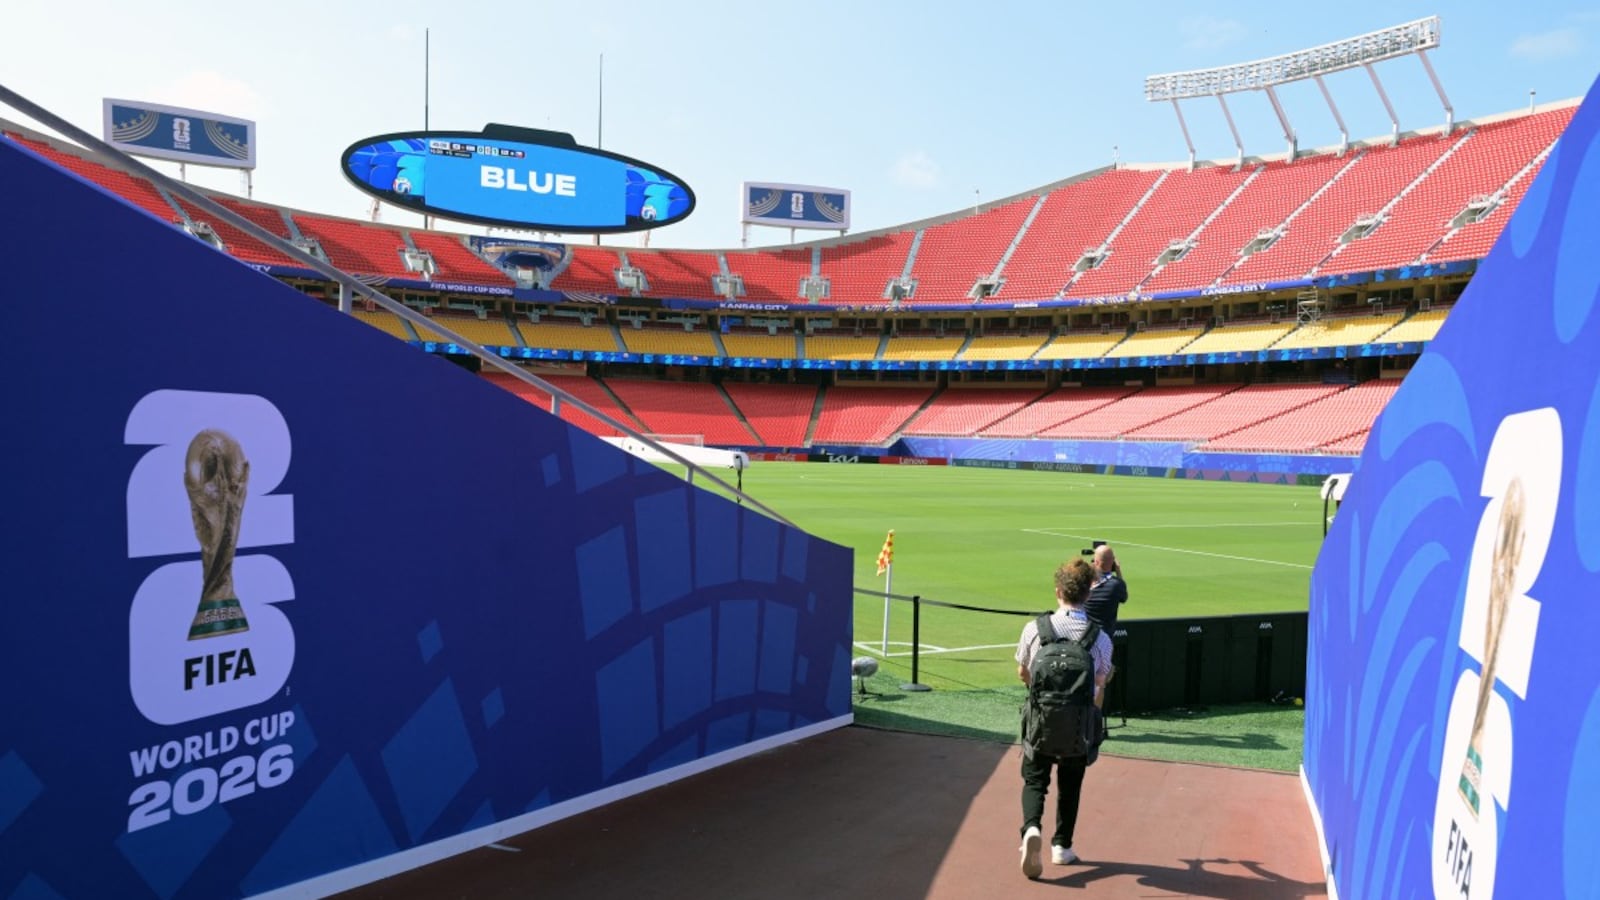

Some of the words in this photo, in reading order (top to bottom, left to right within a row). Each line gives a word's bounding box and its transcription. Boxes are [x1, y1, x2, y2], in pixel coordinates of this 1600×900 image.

[481, 165, 576, 197] BLUE
[431, 282, 446, 290] FIFA
[447, 284, 473, 292] WORLD
[474, 286, 489, 294] CUP
[1201, 285, 1242, 296] KANSAS
[1243, 283, 1267, 292] CITY
[899, 456, 928, 465] Lenovo
[1131, 466, 1148, 476] VISA
[184, 648, 256, 691] FIFA
[129, 726, 239, 778] WORLD
[244, 710, 295, 745] CUP
[127, 744, 294, 833] 2026
[1446, 818, 1473, 900] FIFA
